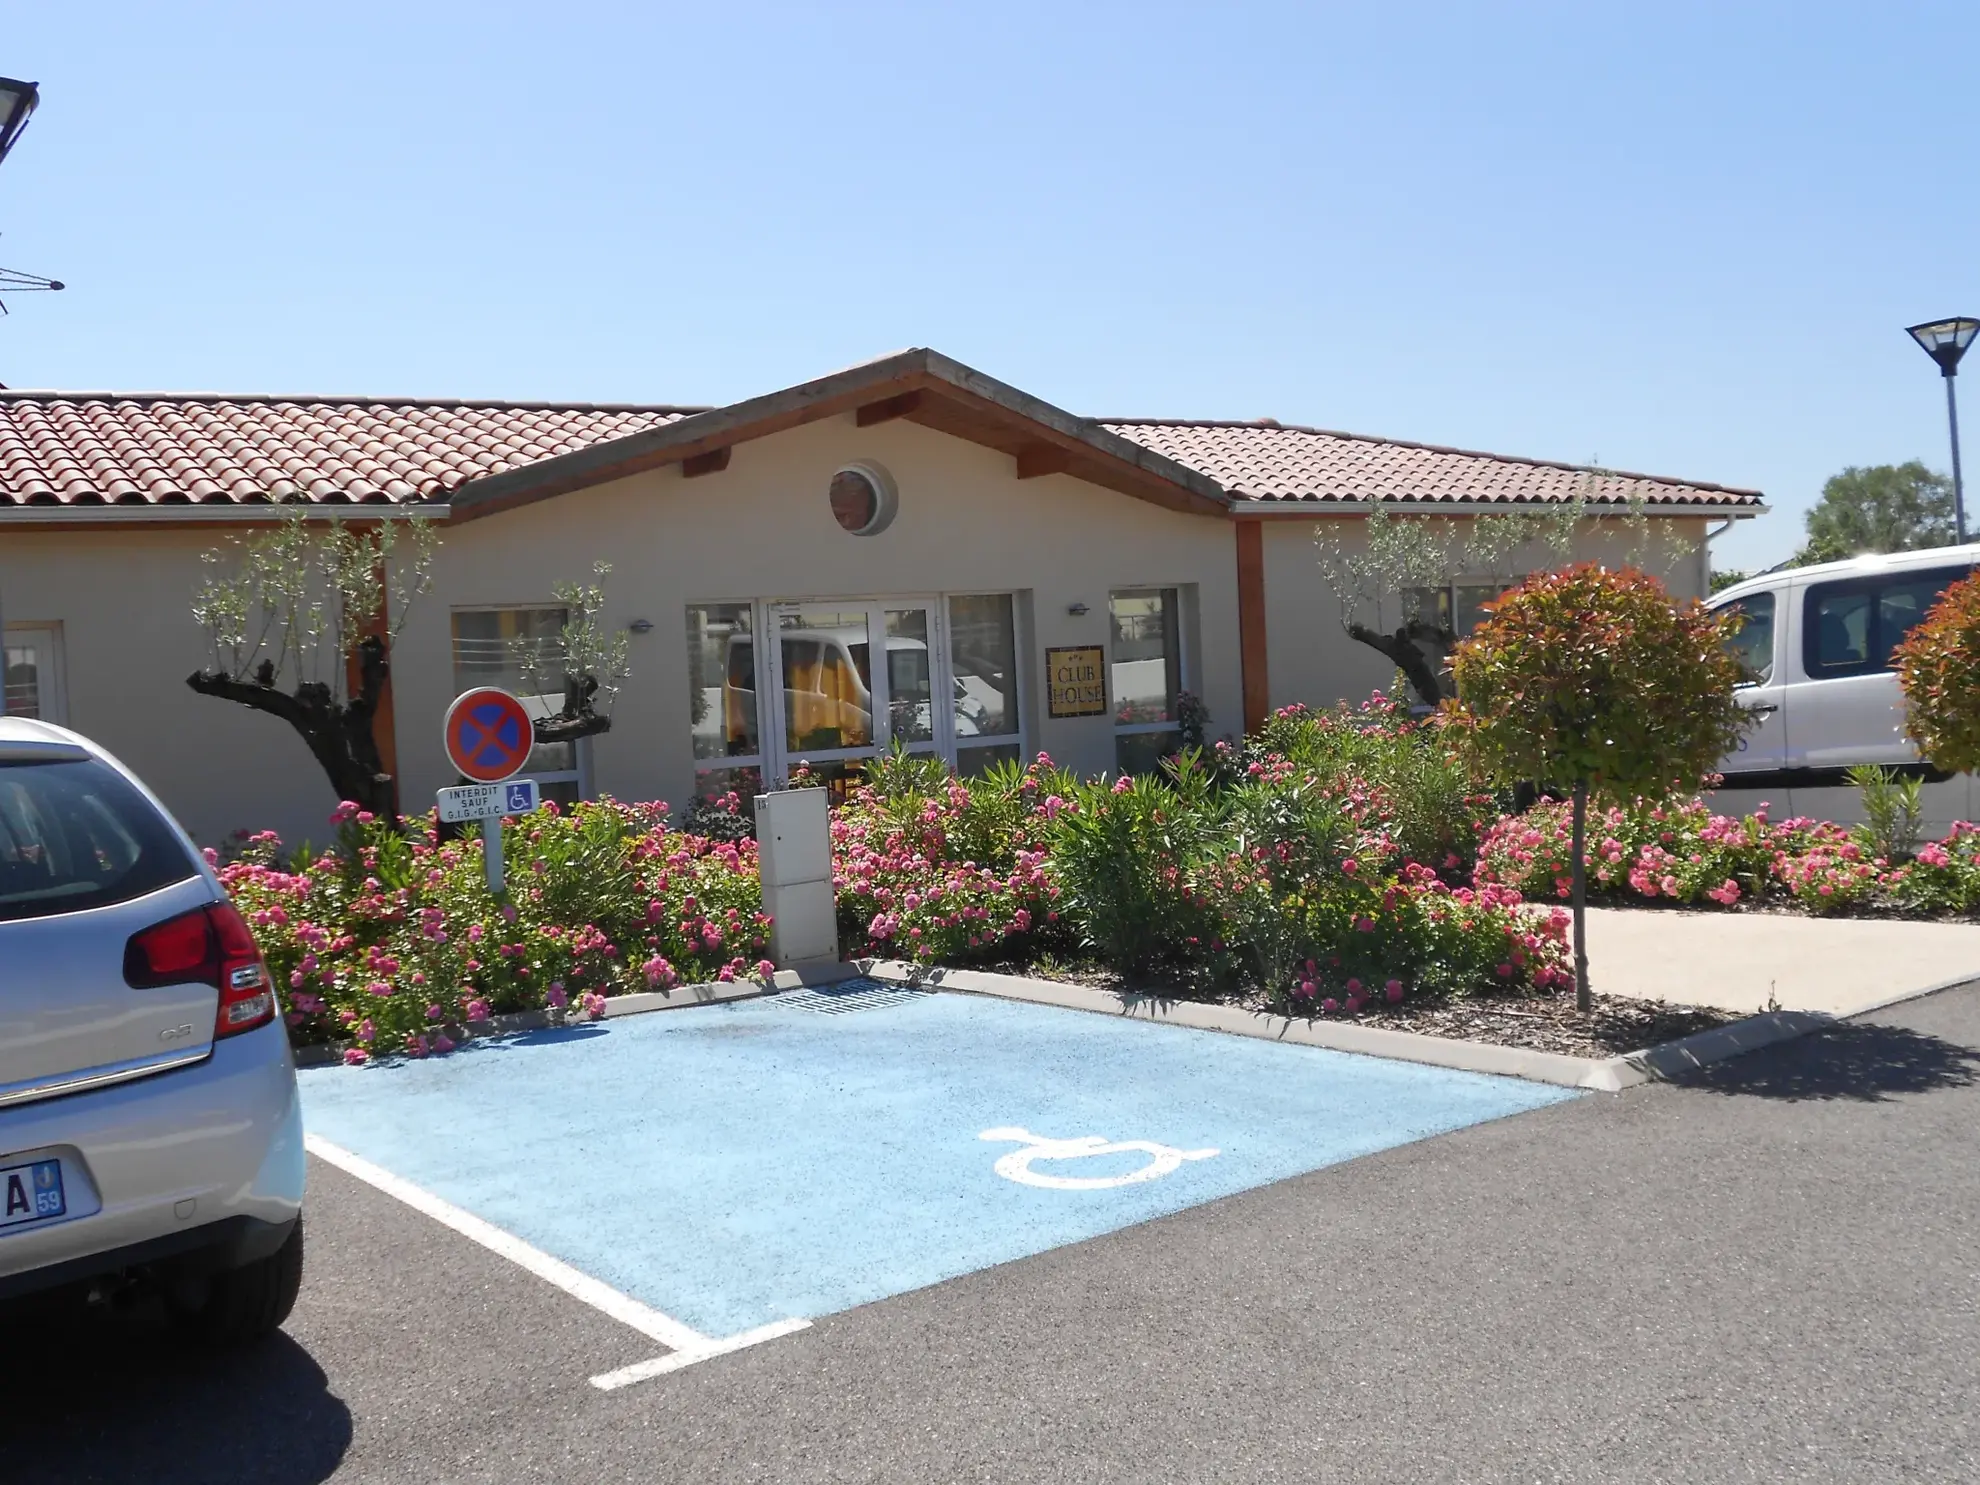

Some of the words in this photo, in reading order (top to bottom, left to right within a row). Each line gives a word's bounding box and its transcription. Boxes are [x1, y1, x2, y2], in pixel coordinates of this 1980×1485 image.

[1058, 666, 1095, 684] CLUB
[1053, 686, 1102, 704] HOUSE
[449, 786, 498, 800] INTERDIT
[461, 797, 488, 808] SAUF
[37, 1190, 60, 1212] 59
